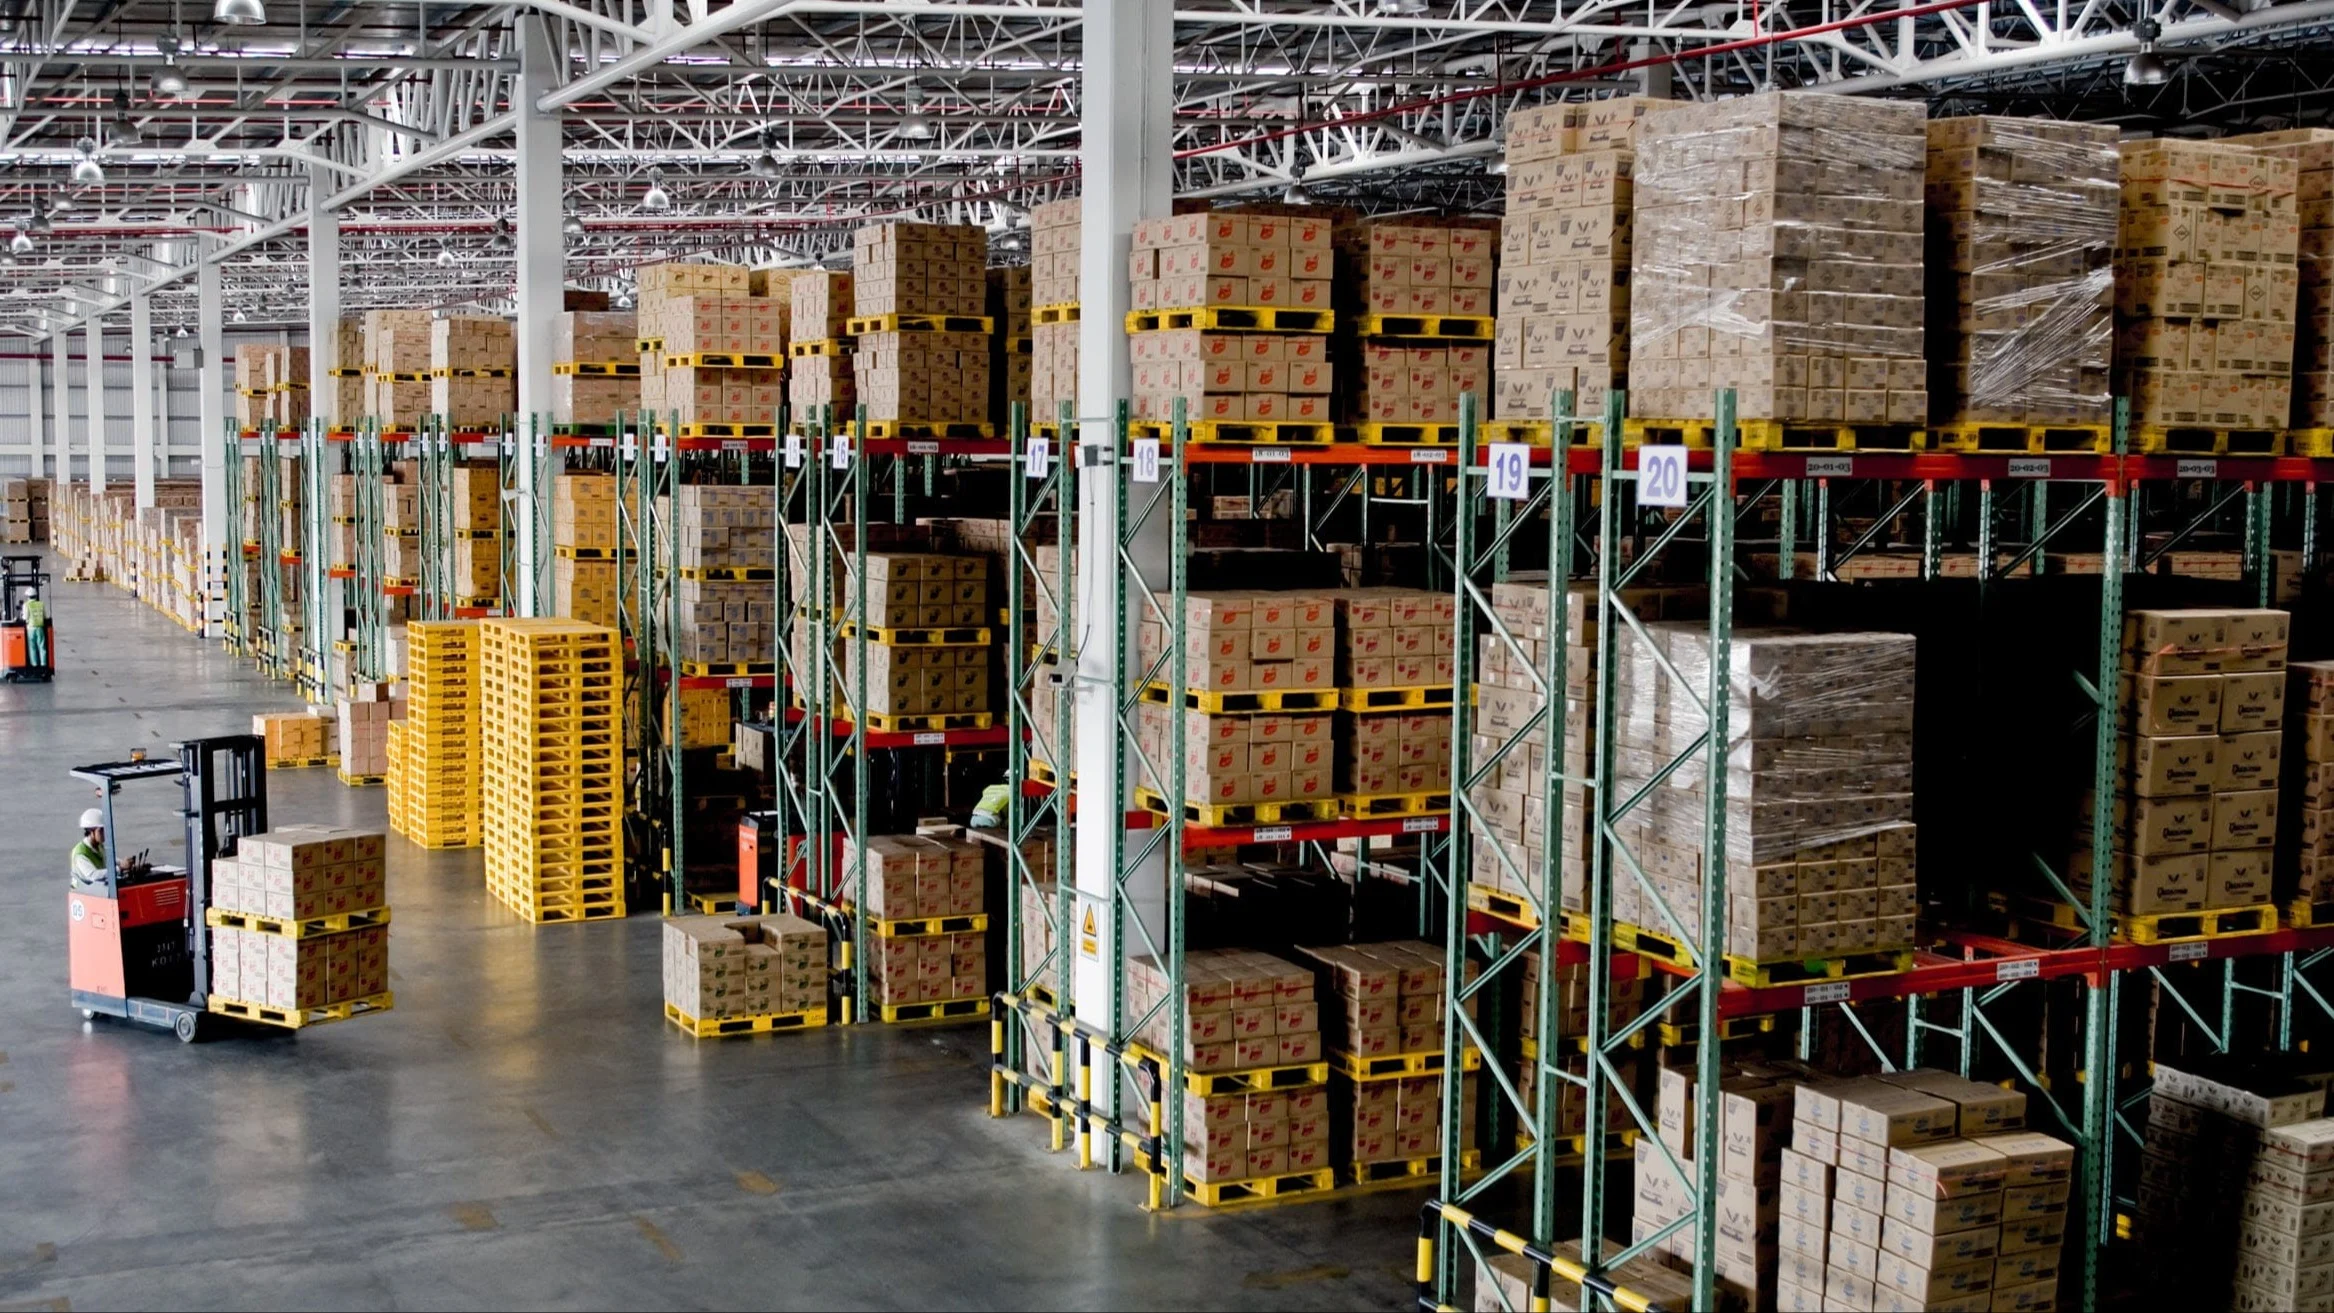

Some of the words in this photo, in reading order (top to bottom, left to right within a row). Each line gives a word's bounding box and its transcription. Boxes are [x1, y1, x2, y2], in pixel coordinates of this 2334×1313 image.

[836, 440, 846, 464] 16
[1030, 444, 1045, 472] 17
[1138, 445, 1155, 477] 18
[1496, 452, 1522, 491] 19
[1646, 455, 1679, 498] 20
[1808, 463, 1851, 473] 20-01-03
[2010, 463, 2048, 473] 20-02-03
[2178, 463, 2215, 474] 20-03-03
